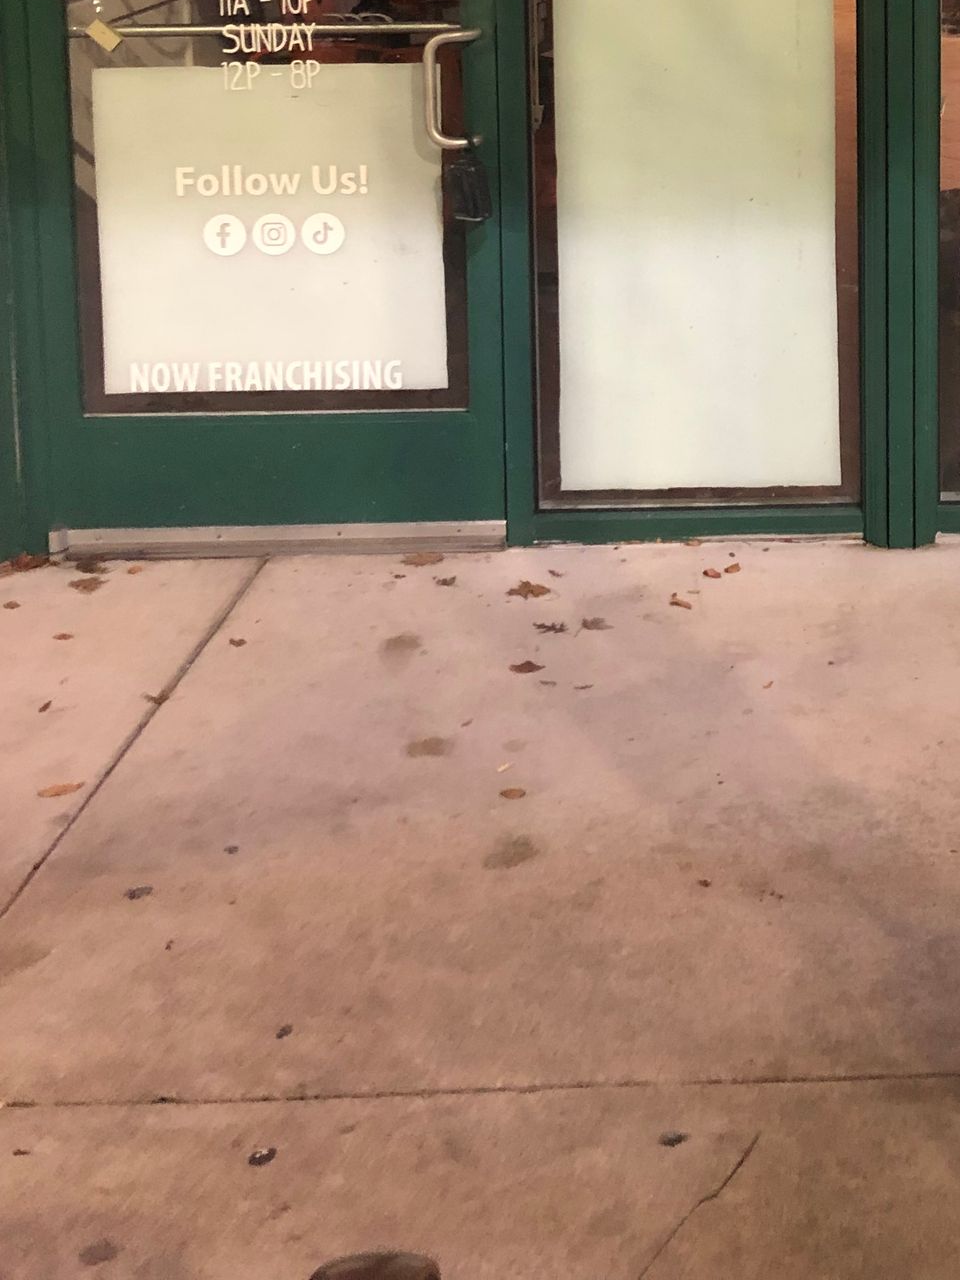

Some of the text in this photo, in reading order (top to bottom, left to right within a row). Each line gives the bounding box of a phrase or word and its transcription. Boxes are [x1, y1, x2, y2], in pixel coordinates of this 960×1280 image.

[222, 22, 317, 54] SUNDAY
[221, 61, 261, 90] 12P
[290, 59, 321, 89] 8P
[175, 164, 369, 197] Follow Us!
[129, 359, 404, 393] NOW FRANCHISING
